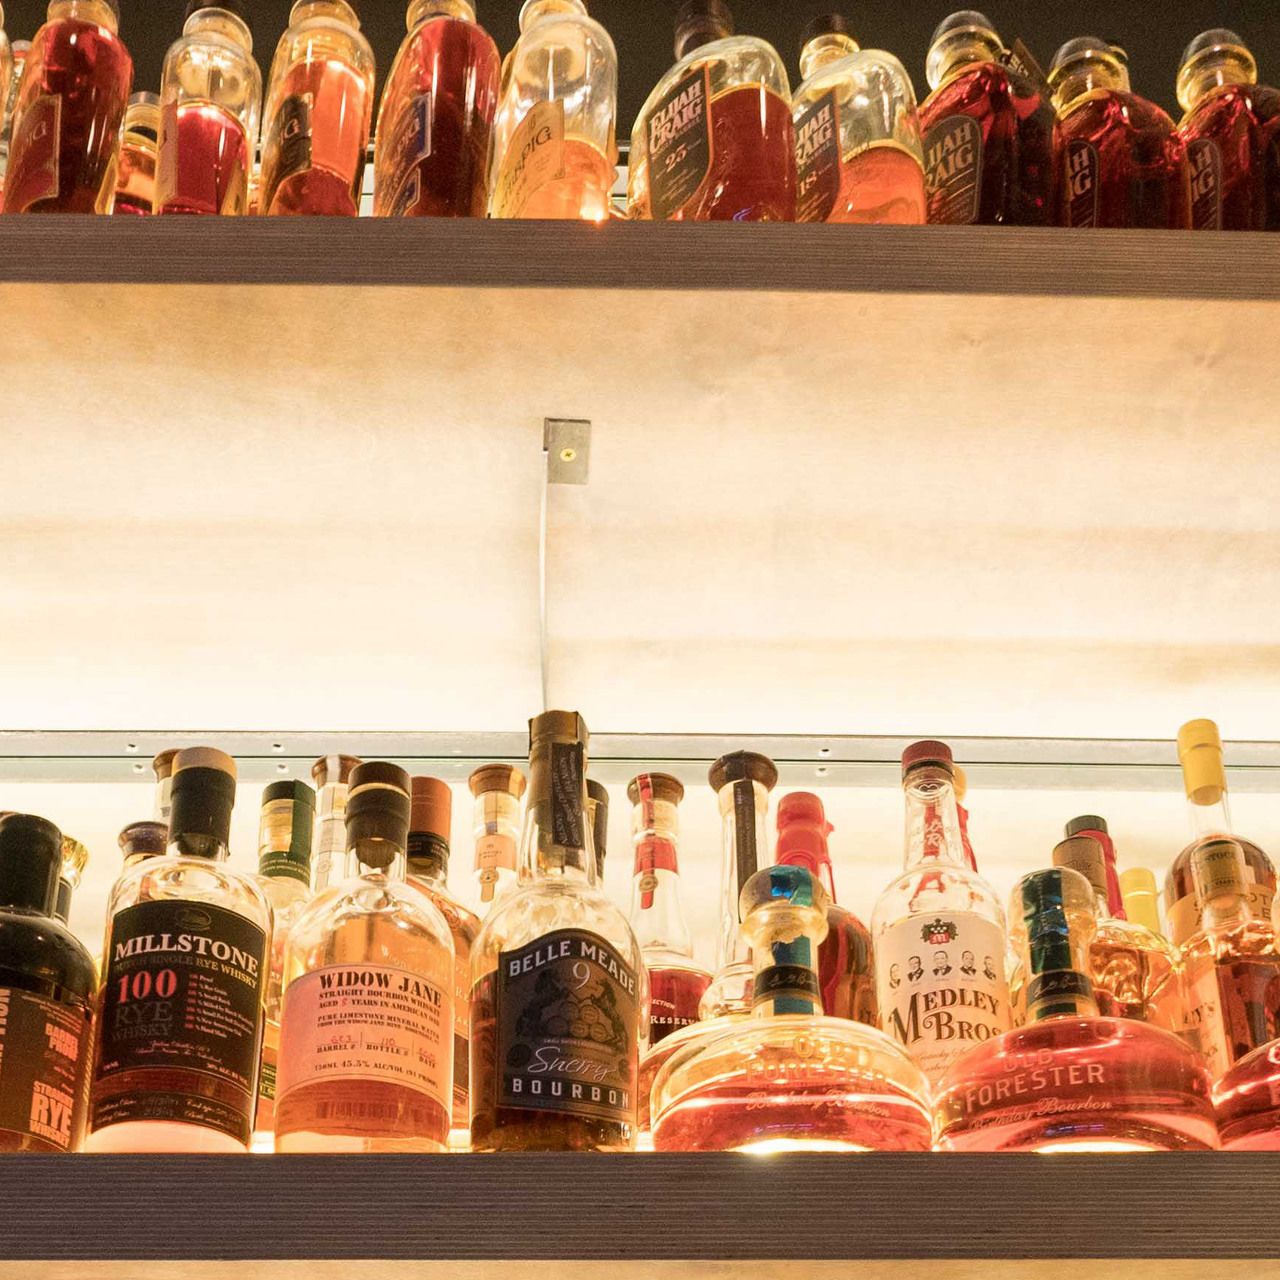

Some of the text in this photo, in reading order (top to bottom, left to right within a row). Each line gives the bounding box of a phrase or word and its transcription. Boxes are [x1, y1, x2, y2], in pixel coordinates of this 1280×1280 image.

[650, 79, 702, 136] ELIJAH
[650, 98, 703, 153] CRAIG
[114, 933, 258, 978] MILLSTONE
[509, 940, 635, 996] BELLE MEADE
[117, 968, 178, 1004] 100
[196, 957, 219, 971] RYE
[221, 964, 258, 989] WHISKY
[320, 971, 442, 1008] WIDOW JANE
[572, 961, 591, 990] 9
[319, 988, 365, 1001] STRAIGHT
[367, 989, 409, 1004] BOURBON
[351, 999, 379, 1008] YEARS
[392, 1002, 428, 1020] AMERICAN
[339, 1011, 385, 1021] LIMESTONE
[888, 988, 1001, 1044] MEDLEY
[341, 1059, 370, 1069] 45.5%
[366, 1043, 400, 1055] BOTTLE
[512, 1078, 630, 1107] BOURBON
[965, 1063, 1105, 1113] FORESTER
[30, 1091, 73, 1133] RYE
[1037, 1096, 1113, 1117] Bourbon
